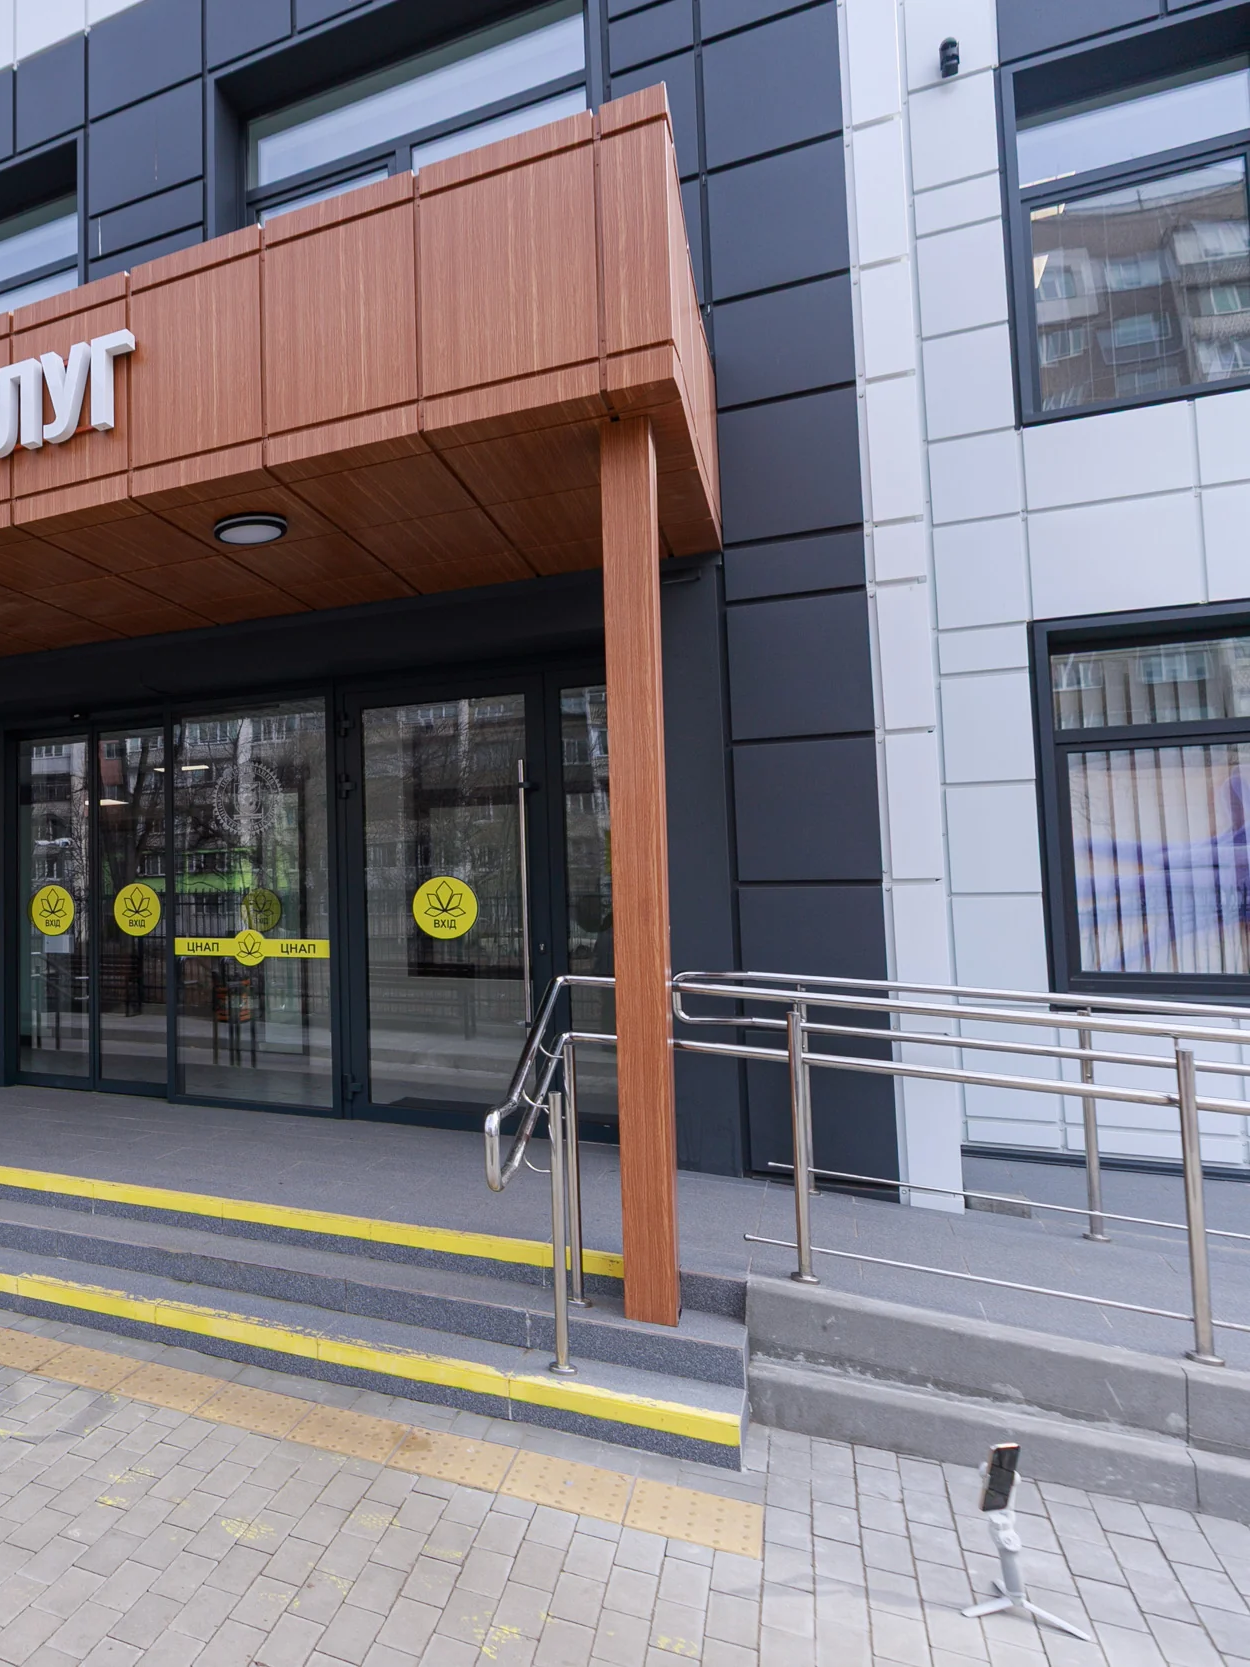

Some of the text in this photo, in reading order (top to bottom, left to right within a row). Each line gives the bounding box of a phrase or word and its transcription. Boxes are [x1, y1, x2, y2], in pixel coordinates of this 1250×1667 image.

[45, 919, 61, 928] ВХІД
[128, 919, 146, 928] ВХІД
[433, 919, 457, 930] ВХІД
[187, 942, 316, 954] ЦНАП ЦНАП
